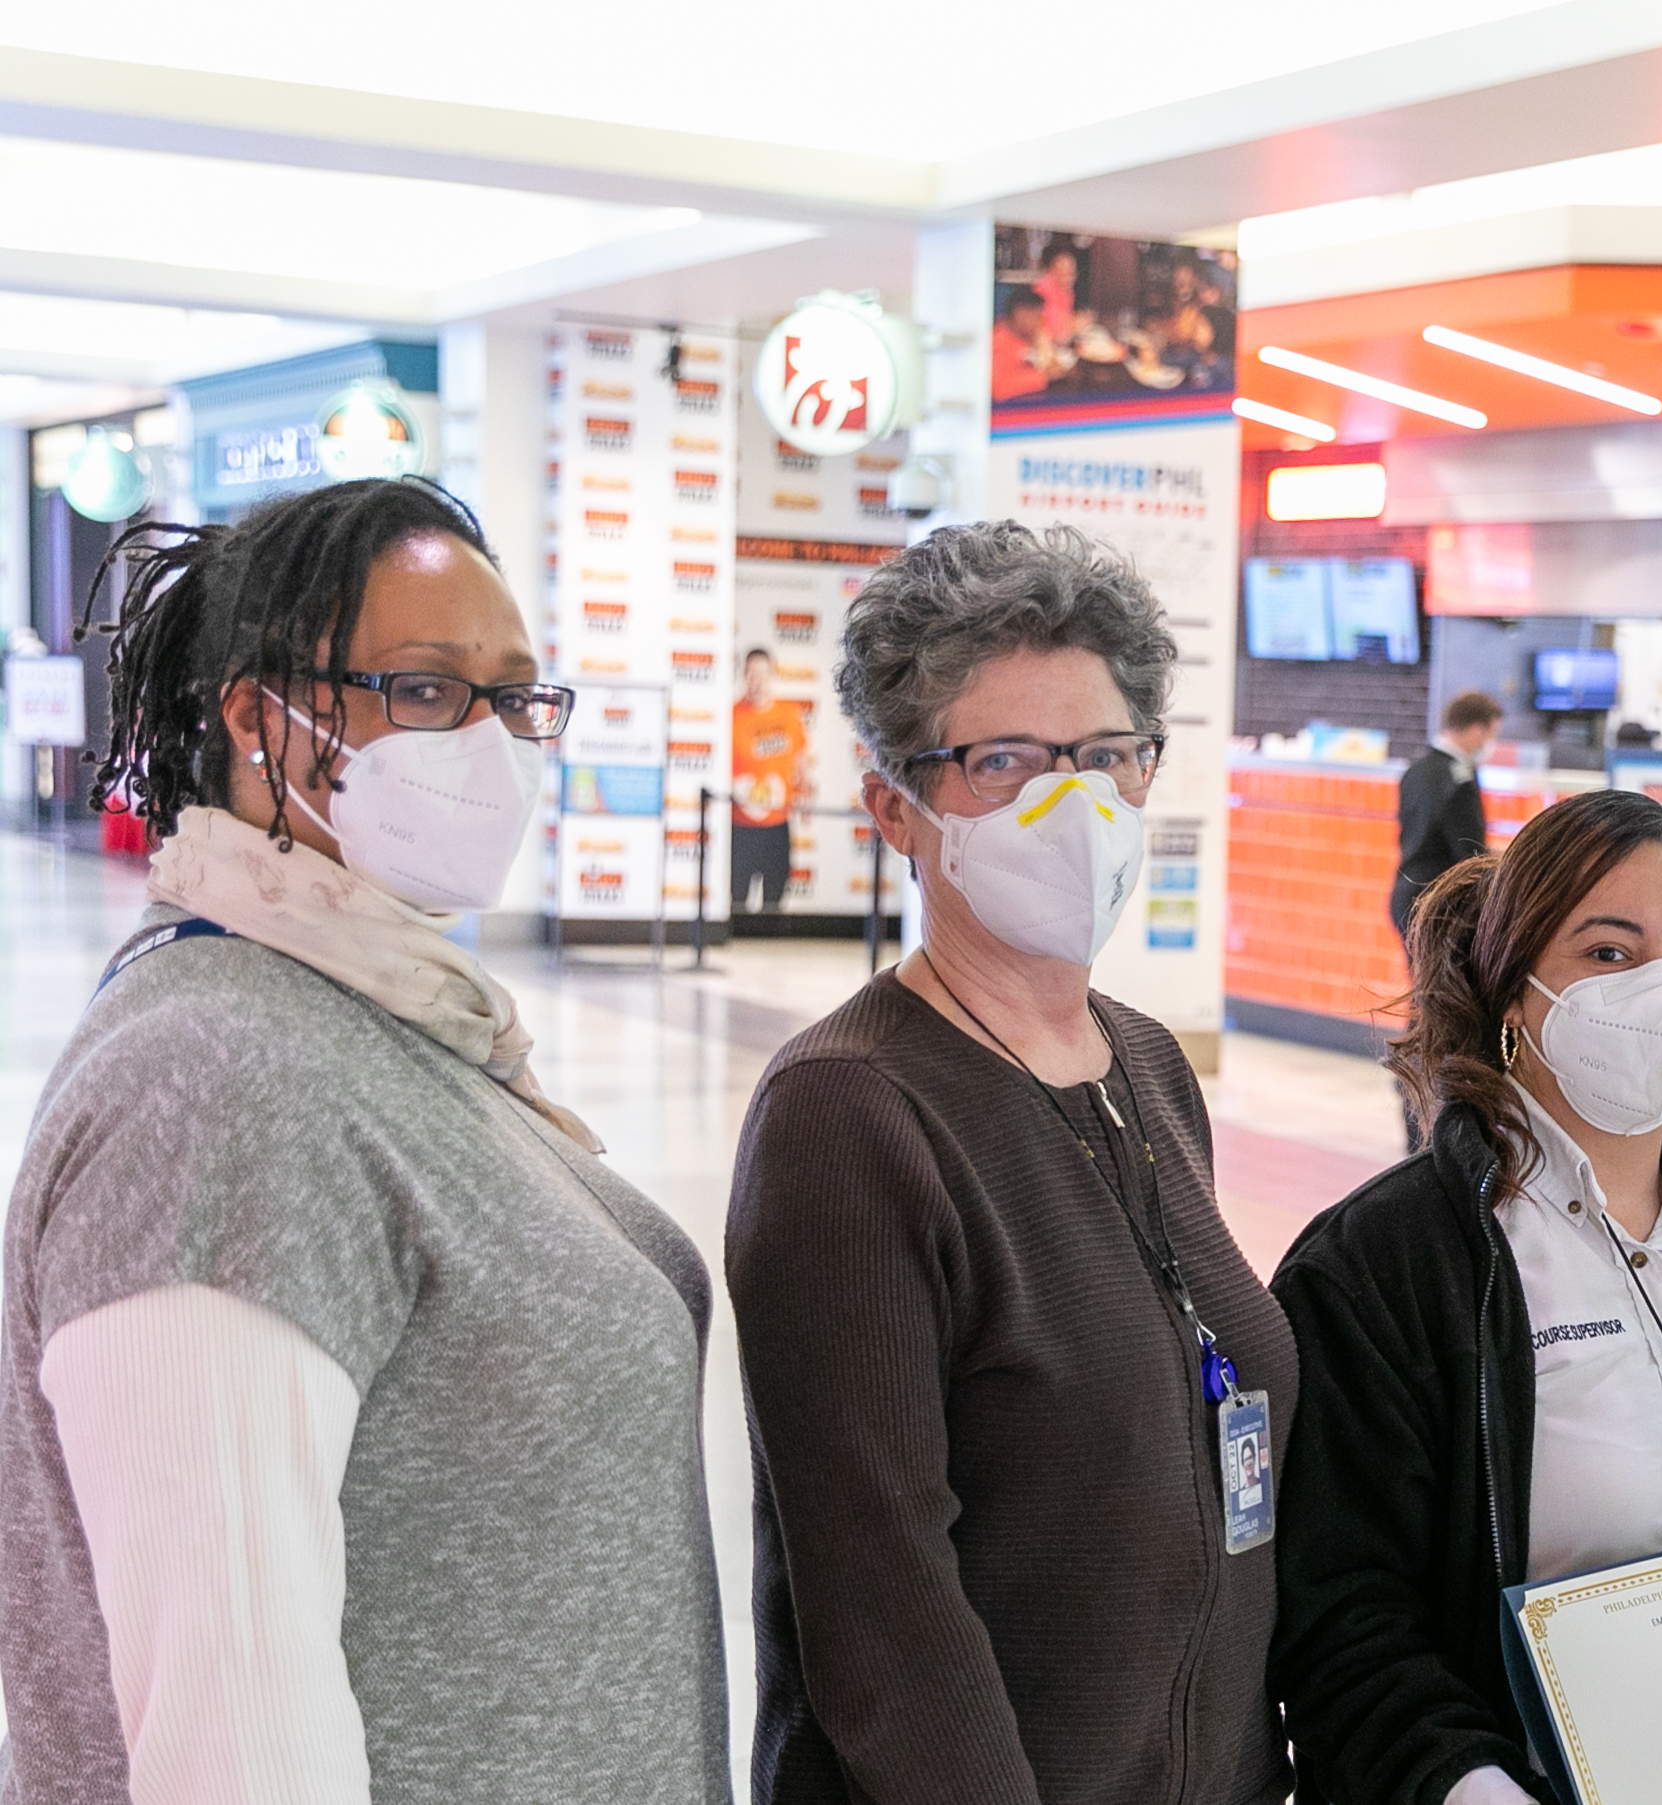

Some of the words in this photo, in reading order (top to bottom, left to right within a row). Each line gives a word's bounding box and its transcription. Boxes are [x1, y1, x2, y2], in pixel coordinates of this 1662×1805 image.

[1133, 499, 1207, 519] GUIDE
[379, 821, 416, 844] KN95
[1579, 1055, 1607, 1072] KN95
[1228, 1444, 1236, 1458] 22
[1229, 1463, 1237, 1490] OCT
[1232, 1512, 1246, 1525] LEAH
[1232, 1518, 1260, 1537] DOUGLAS
